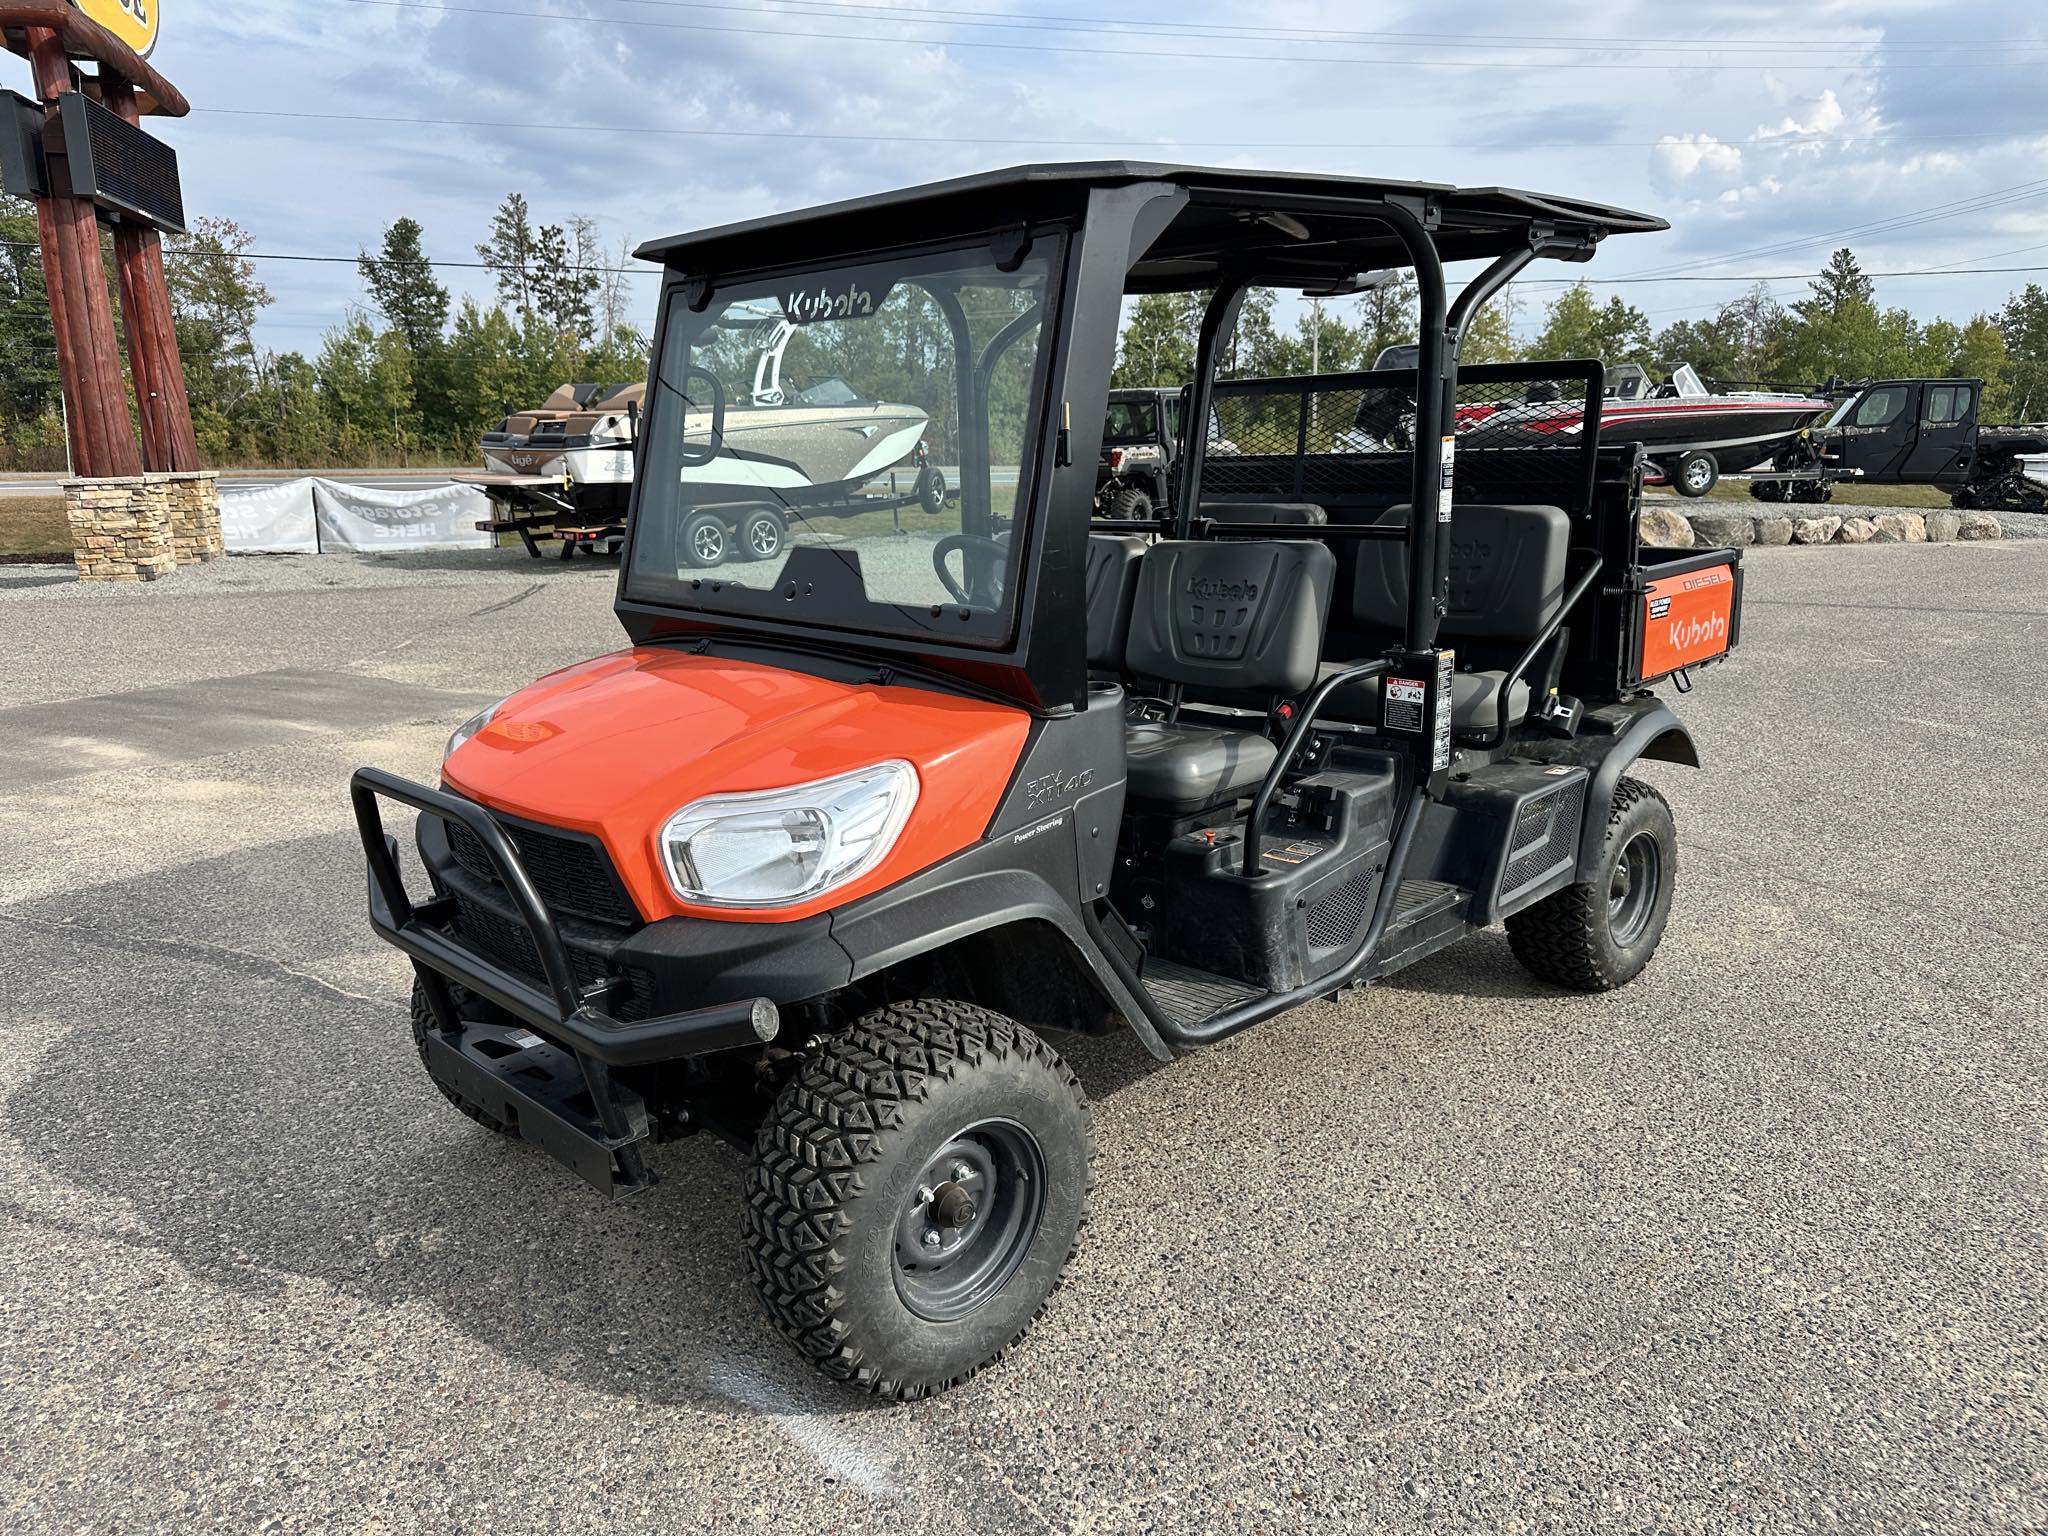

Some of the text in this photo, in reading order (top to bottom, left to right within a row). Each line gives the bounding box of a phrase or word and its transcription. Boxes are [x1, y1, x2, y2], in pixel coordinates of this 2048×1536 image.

[787, 283, 873, 319] Kubota
[1187, 576, 1258, 602] Kubota
[1682, 574, 1726, 591] DIESEL
[1669, 610, 1725, 650] Kubota
[1013, 817, 1063, 844] Power Steering
